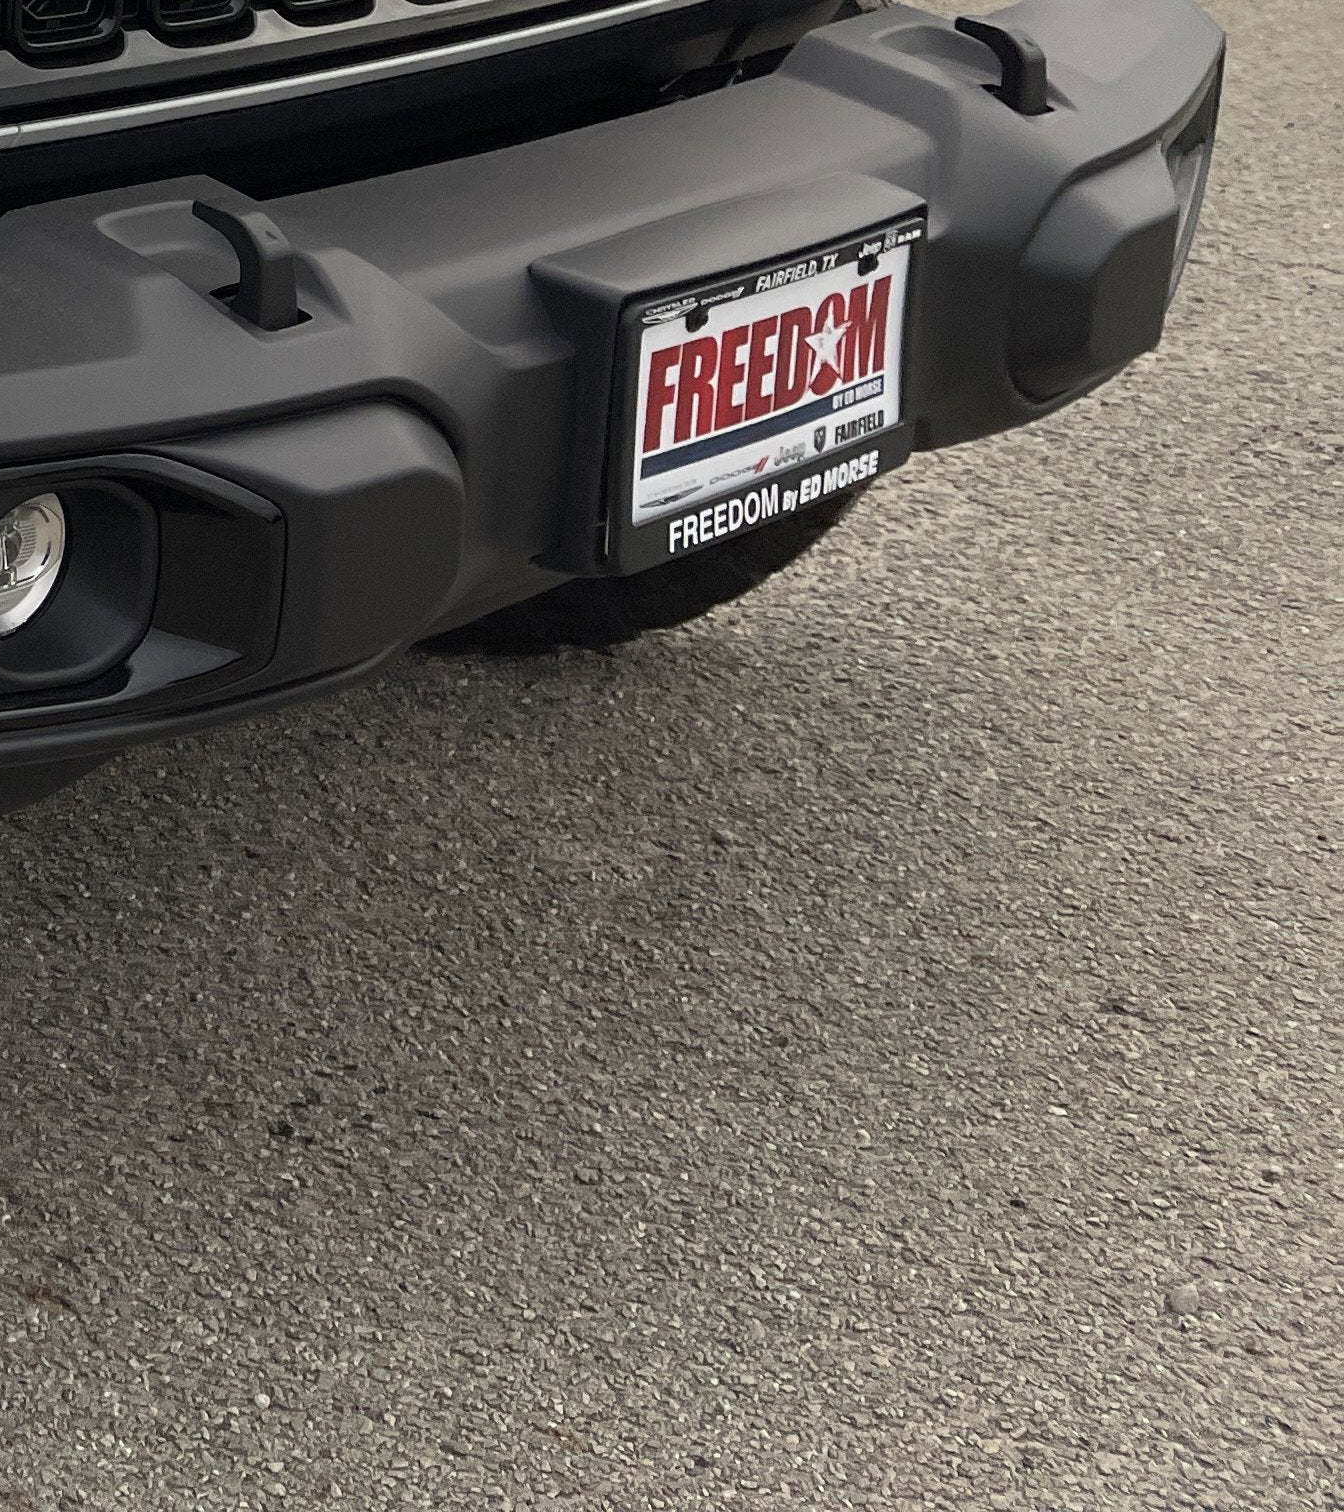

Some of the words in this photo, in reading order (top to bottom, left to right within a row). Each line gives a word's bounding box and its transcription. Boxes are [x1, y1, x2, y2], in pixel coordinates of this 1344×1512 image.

[822, 252, 840, 271] TX
[642, 275, 892, 453] FREEDOM
[835, 409, 884, 445] FAIRFIELD
[774, 441, 806, 467] Jeep
[668, 483, 779, 554] FREEDOM
[799, 474, 822, 505] ED
[823, 449, 880, 495] MORSE
